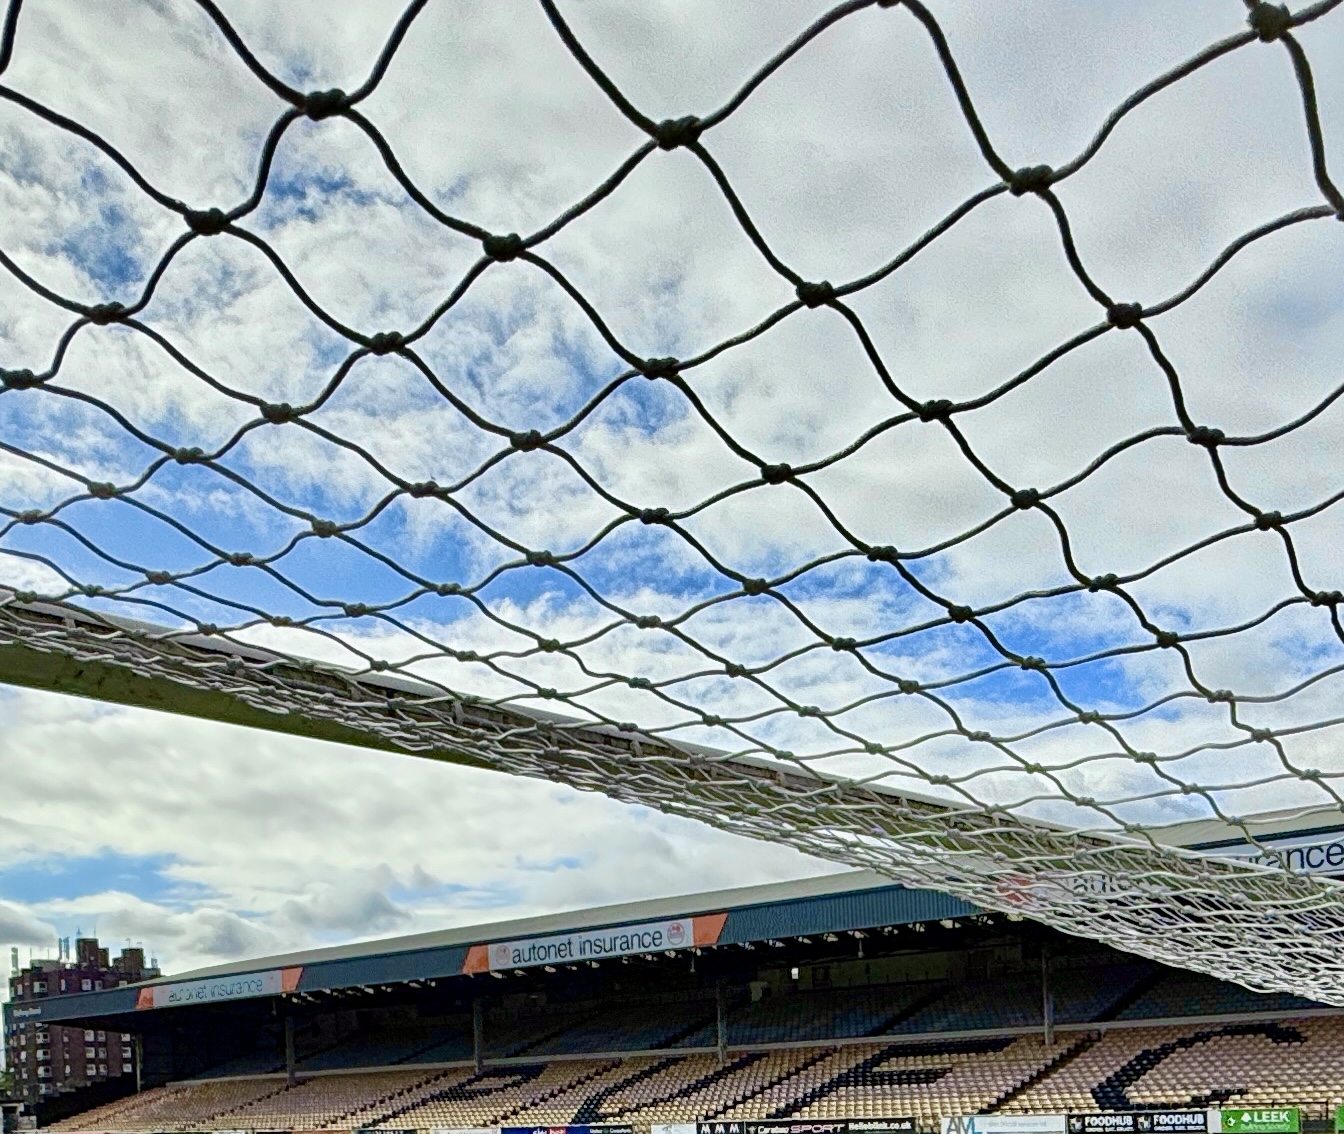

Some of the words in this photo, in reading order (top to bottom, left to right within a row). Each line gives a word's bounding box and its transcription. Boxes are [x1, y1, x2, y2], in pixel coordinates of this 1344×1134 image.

[512, 937, 574, 965] autonet
[579, 930, 663, 957] insurance
[168, 985, 208, 1003] autonet
[210, 980, 264, 998] insurance
[1084, 1115, 1134, 1127] FOODHUB
[1153, 1113, 1205, 1125] FOODHUB
[1253, 1110, 1291, 1123] LEEK
[790, 1124, 846, 1134] SPORT
